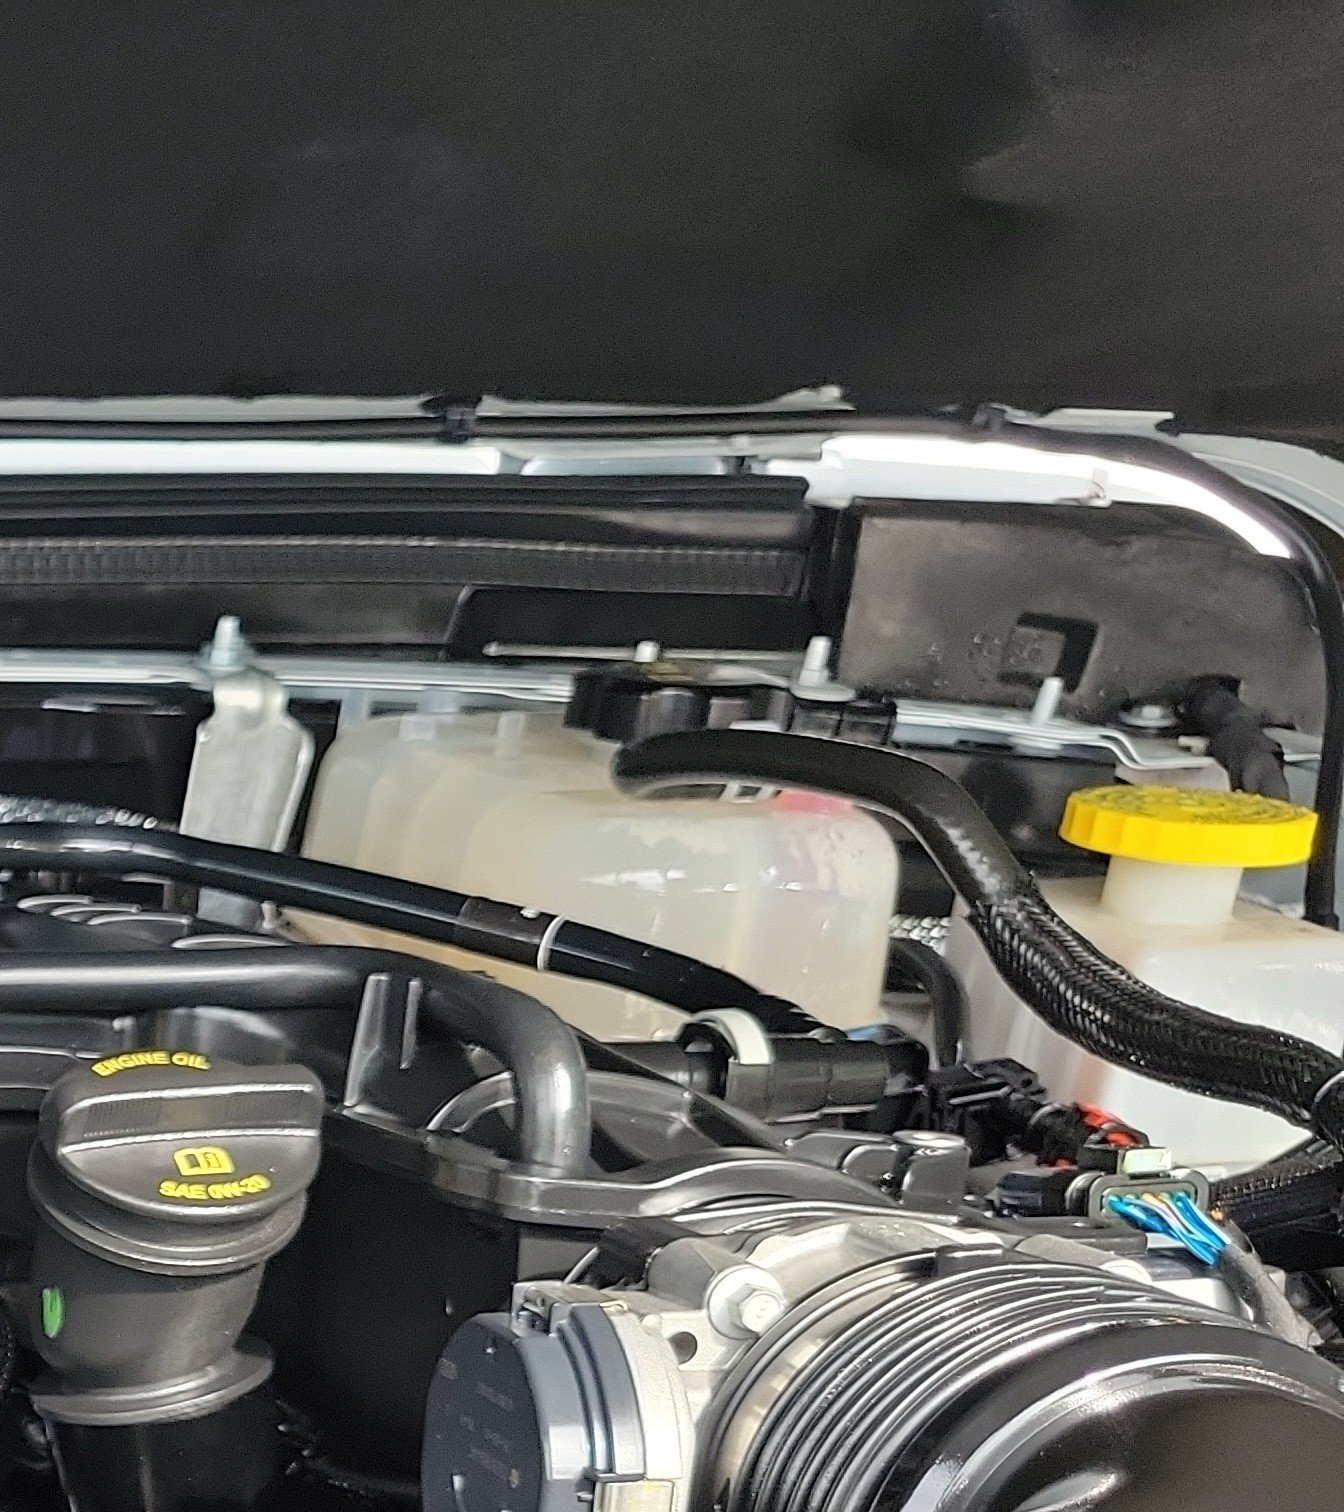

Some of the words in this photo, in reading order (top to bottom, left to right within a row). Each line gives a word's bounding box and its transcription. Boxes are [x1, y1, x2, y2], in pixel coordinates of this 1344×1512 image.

[91, 1050, 170, 1077] ENGINE
[171, 1052, 211, 1071] OIL
[159, 1179, 209, 1200] SAE
[208, 1174, 271, 1199] 0W-20
